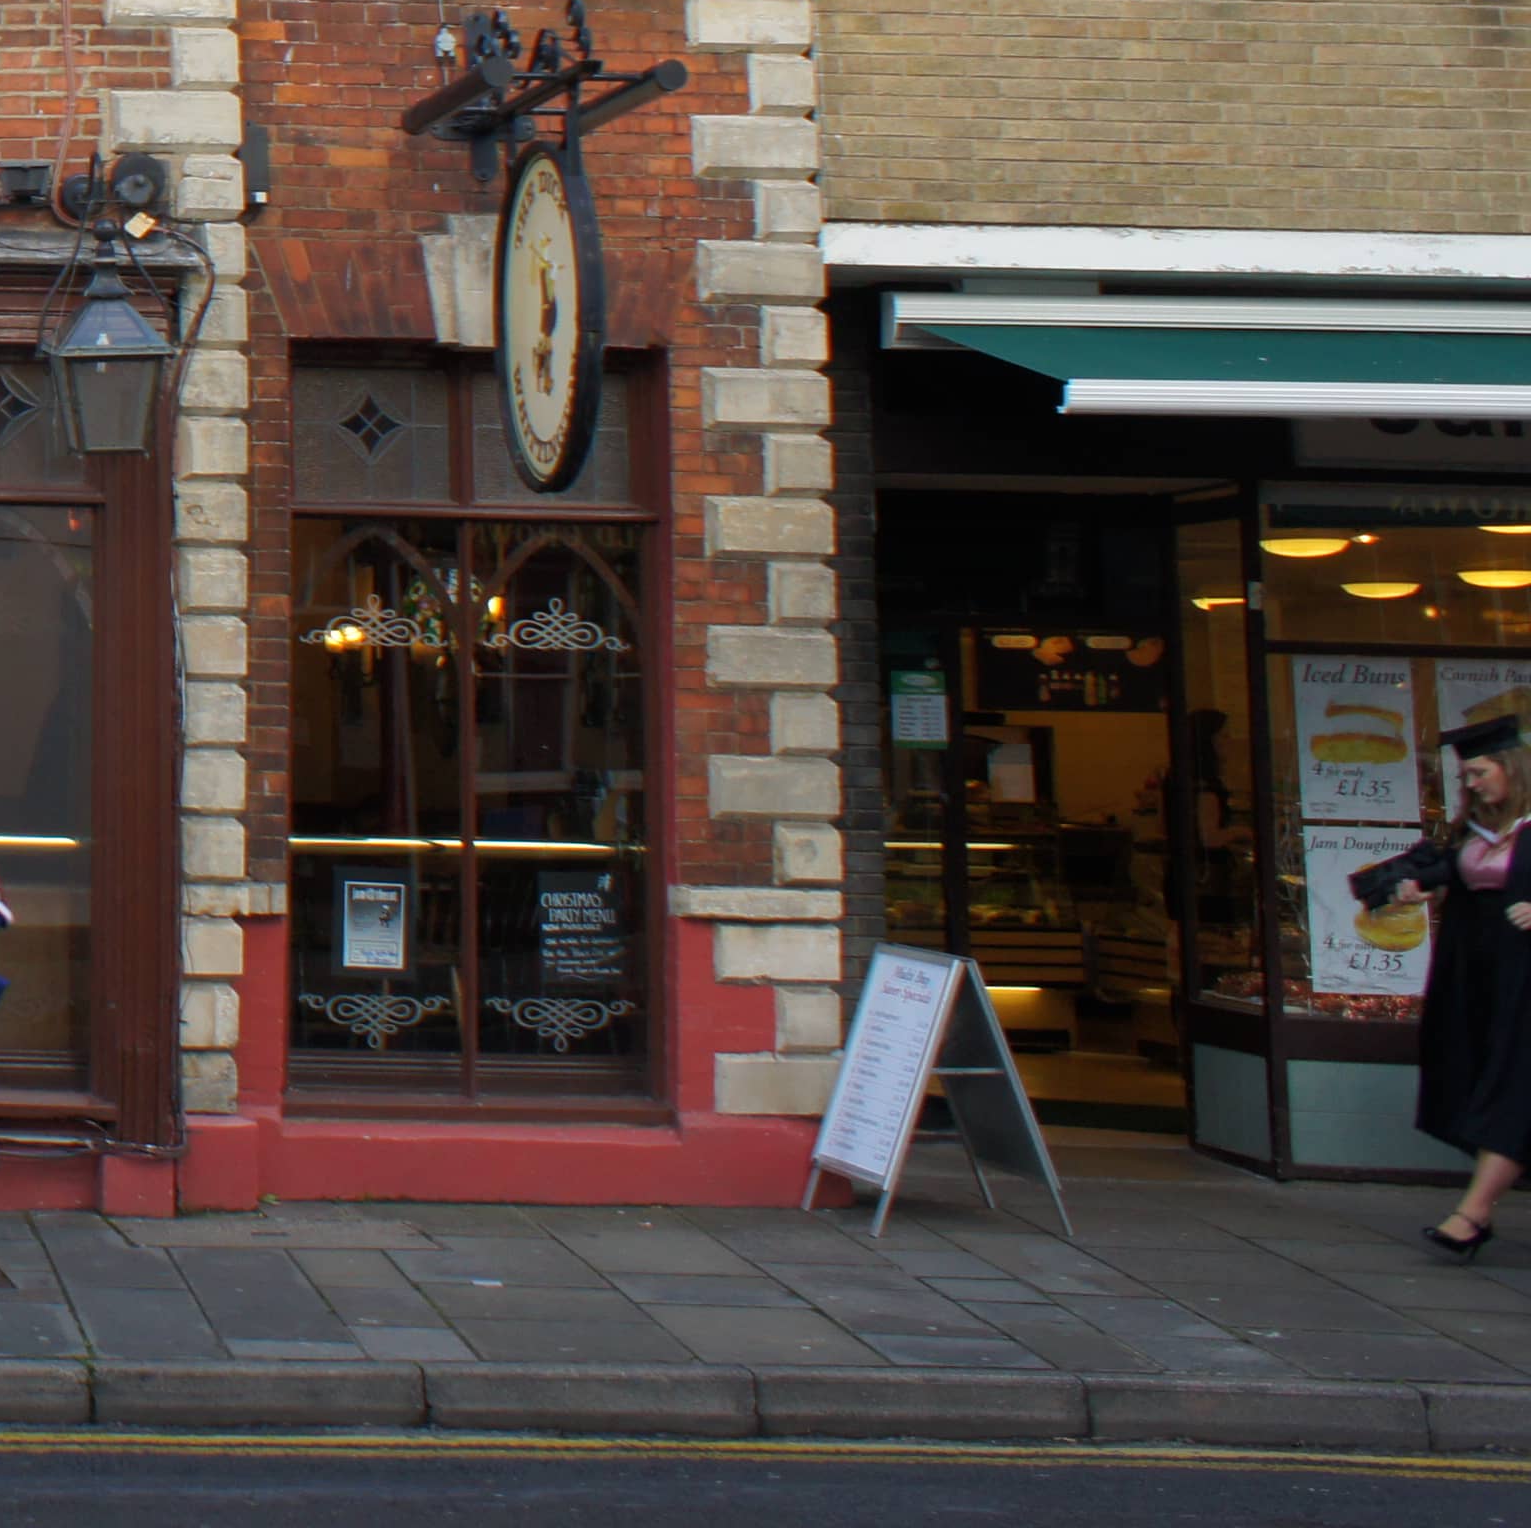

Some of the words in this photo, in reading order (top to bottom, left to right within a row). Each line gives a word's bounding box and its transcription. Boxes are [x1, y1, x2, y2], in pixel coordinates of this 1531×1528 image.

[1301, 663, 1347, 684] Iced
[1351, 665, 1406, 685] Buns
[1439, 666, 1500, 682] Cornish
[1310, 761, 1324, 776] 4
[1342, 767, 1364, 780] only
[1335, 779, 1393, 799] £1.35
[1306, 835, 1338, 852] Jam
[1323, 932, 1335, 949] 4
[1346, 952, 1404, 972] £1.35
